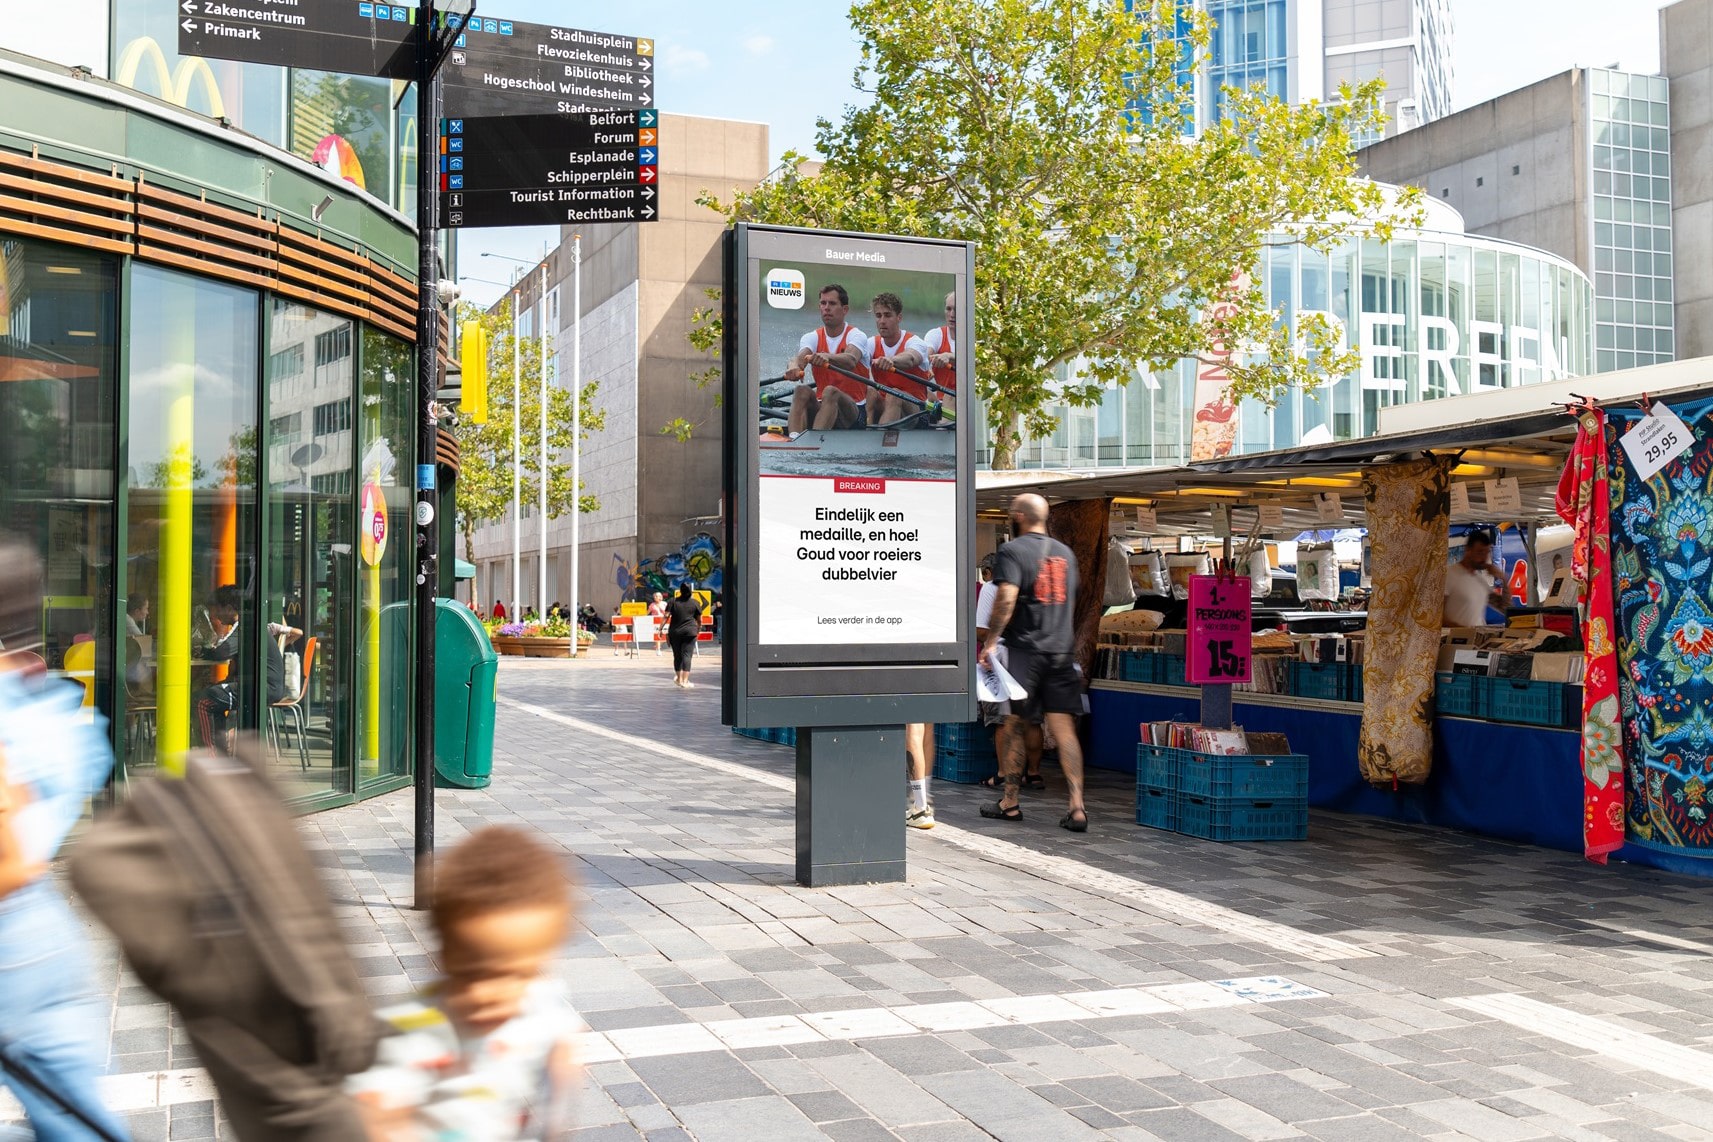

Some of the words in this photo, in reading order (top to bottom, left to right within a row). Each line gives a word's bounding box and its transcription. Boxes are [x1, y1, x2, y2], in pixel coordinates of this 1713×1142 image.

[204, 1, 306, 25] Zakencentrum
[205, 22, 261, 40] Primark
[550, 28, 633, 50] Stadhuisplein
[537, 44, 633, 67] Flevoziekenhuis
[564, 66, 633, 84] Bibliotheek
[484, 73, 556, 93] Hogeschool
[559, 82, 633, 102] Windesheim
[589, 112, 635, 126] Belfort
[594, 132, 634, 144] Forum
[569, 150, 635, 165] Esplanade
[547, 168, 634, 184] Schipperplein
[510, 190, 554, 203] Tourist
[558, 187, 634, 201] Information
[567, 208, 635, 221] Rechtbank
[825, 249, 854, 261] Bauer
[856, 251, 886, 263] Media
[770, 288, 802, 297] NIEUWS
[1640, 423, 1666, 446] Strandlaken
[1645, 431, 1678, 464] 29,95
[839, 481, 881, 491] BREAKING
[815, 507, 875, 524] Eindelijk
[878, 510, 904, 522] een
[800, 527, 866, 543] medaille,
[868, 531, 886, 542] en
[889, 529, 919, 542] hoe!
[796, 547, 835, 561] Goud
[838, 550, 870, 561] voor
[873, 547, 922, 561] roeiers
[822, 567, 898, 581] dubbelvier
[817, 616, 837, 625] Lees
[838, 616, 864, 625] verder
[865, 616, 874, 624] in
[874, 616, 886, 625] de
[886, 617, 902, 626] app
[1195, 608, 1247, 622] PERSOONS
